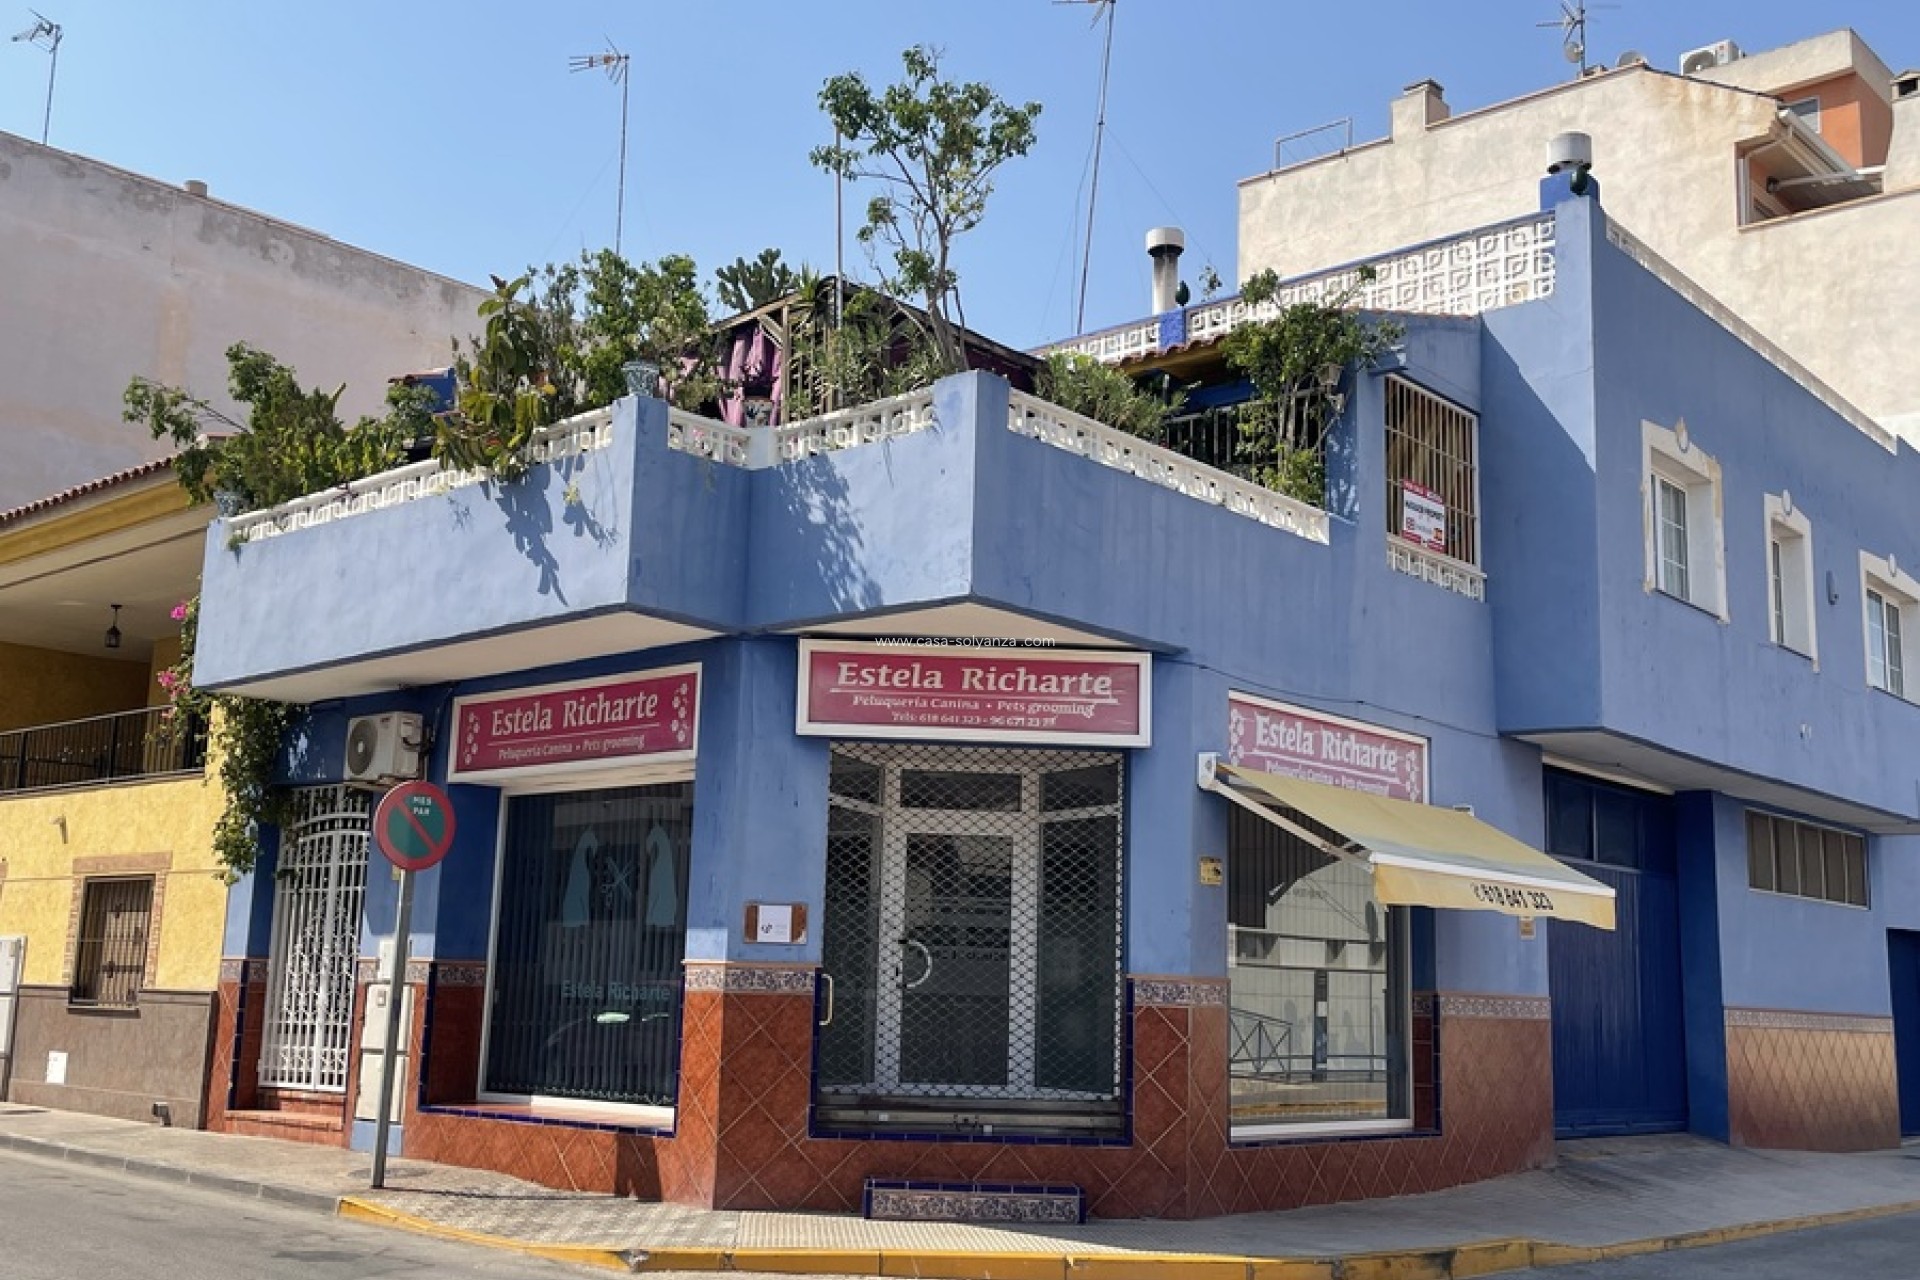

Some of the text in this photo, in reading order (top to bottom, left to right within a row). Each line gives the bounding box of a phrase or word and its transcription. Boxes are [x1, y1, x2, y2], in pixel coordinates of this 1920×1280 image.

[838, 662, 1113, 695] Estela Richarte
[492, 691, 659, 737] Estela Richarte
[930, 698, 979, 710] Canina
[998, 701, 1025, 712] Pets
[1026, 702, 1096, 719] grooming
[1255, 713, 1398, 773] Estela Richarte
[1503, 887, 1528, 909] 641
[1526, 890, 1554, 910] 323
[562, 981, 671, 1001] Estela Richarte
